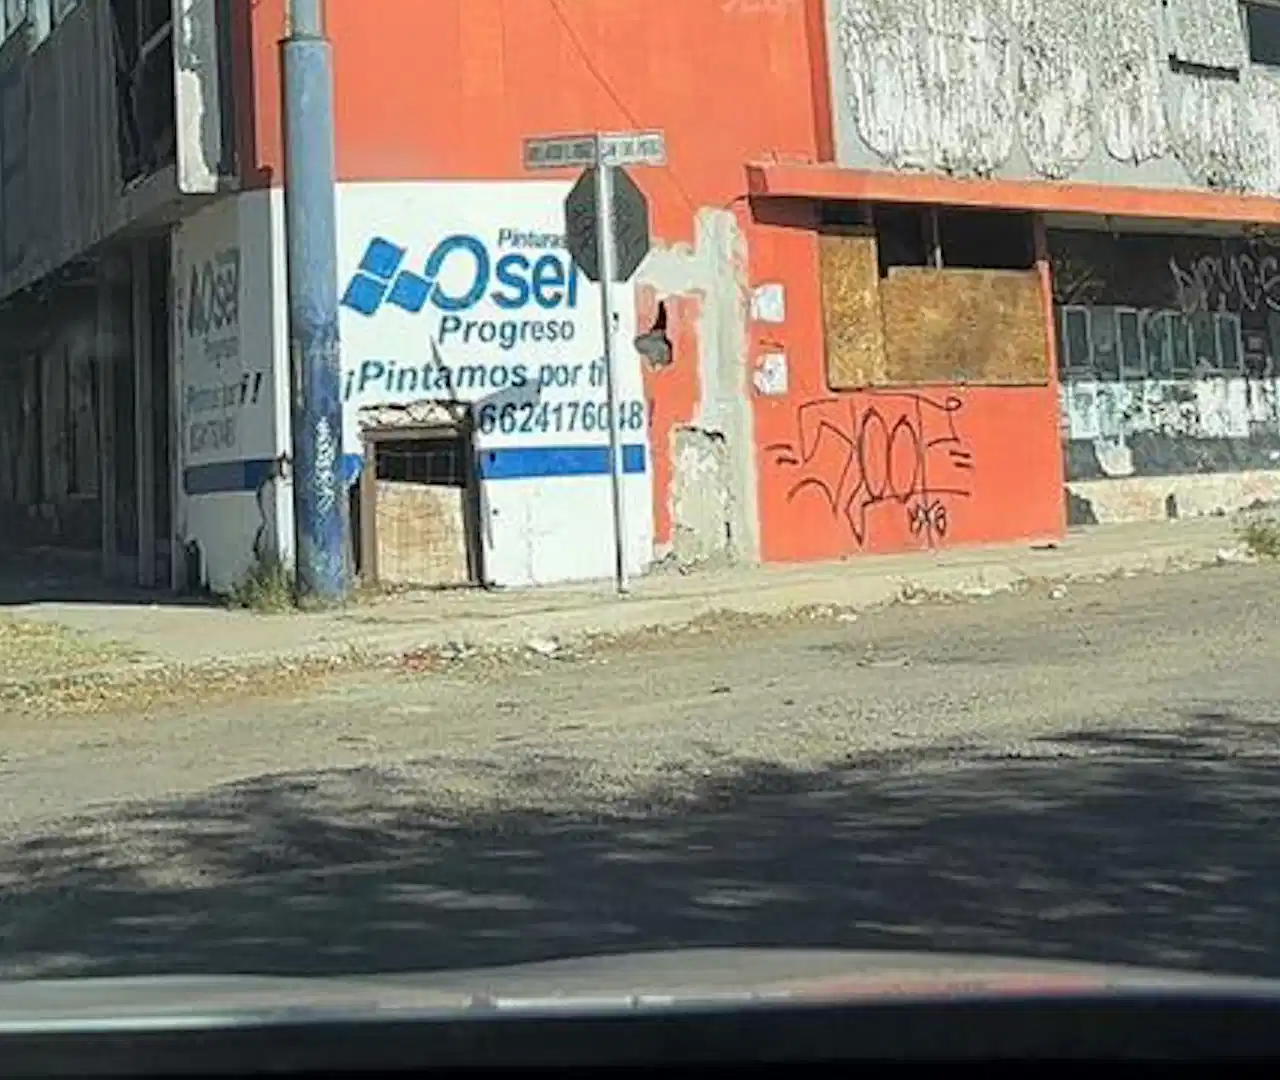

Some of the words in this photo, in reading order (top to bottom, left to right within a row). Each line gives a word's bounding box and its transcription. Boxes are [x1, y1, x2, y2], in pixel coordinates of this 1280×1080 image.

[424, 234, 578, 310] Osel
[438, 316, 575, 349] Progreso
[539, 365, 582, 393] por
